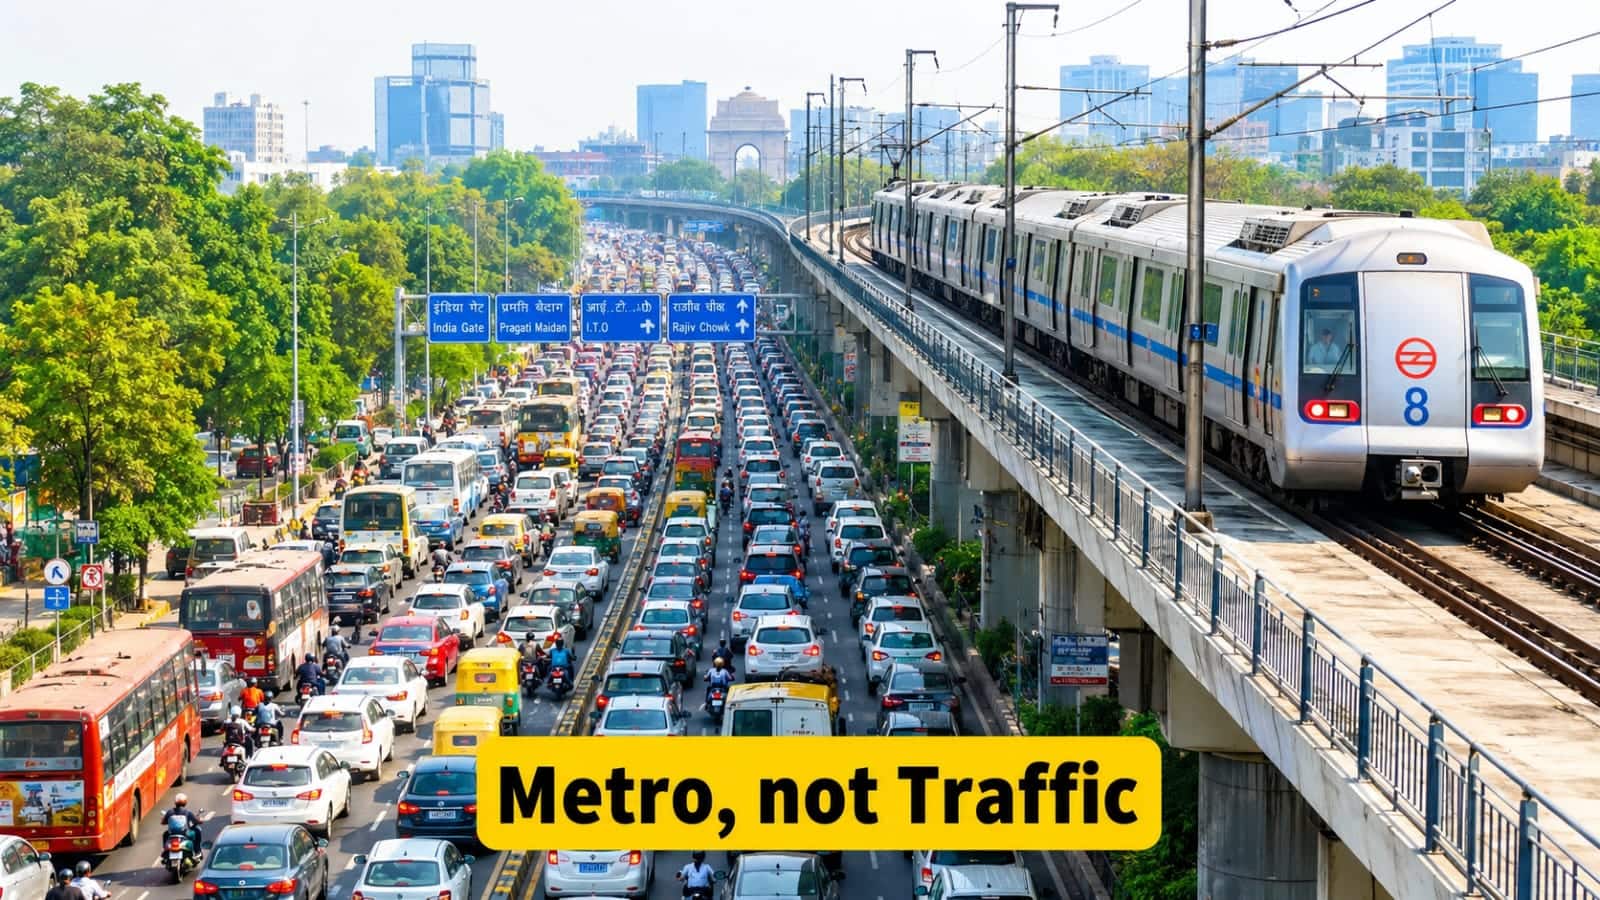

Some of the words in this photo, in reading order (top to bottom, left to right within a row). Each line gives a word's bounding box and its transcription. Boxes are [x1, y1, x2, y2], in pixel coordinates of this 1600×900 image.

[433, 322, 457, 333] India
[461, 322, 484, 333] Gate
[500, 322, 532, 335] Pragati
[535, 322, 567, 333] Maidan
[673, 322, 696, 334] Rajiv
[699, 322, 730, 333] Chowk
[1404, 387, 1430, 427] 8
